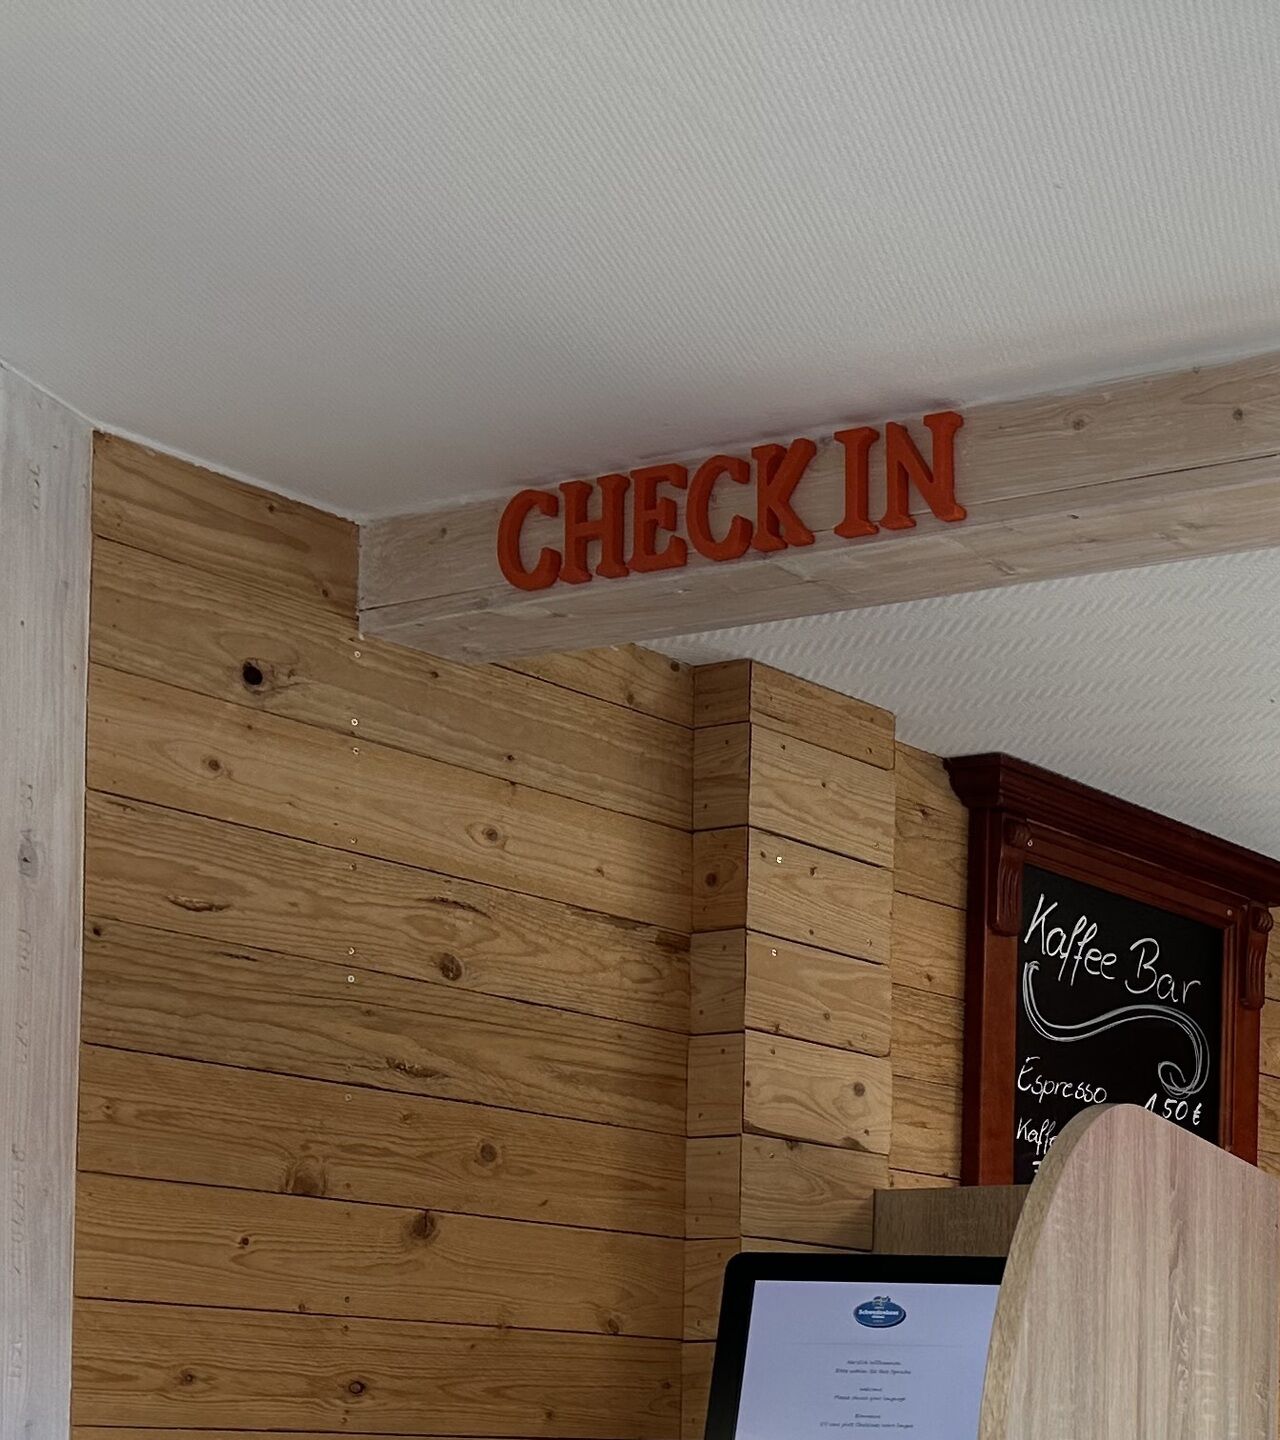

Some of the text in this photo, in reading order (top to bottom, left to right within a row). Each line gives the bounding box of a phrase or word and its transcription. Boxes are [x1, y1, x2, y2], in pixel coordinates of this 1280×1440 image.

[497, 411, 965, 590] CHECK IN
[1024, 893, 1201, 1003] Kaffee Bar
[1017, 1056, 1107, 1103] Espresso
